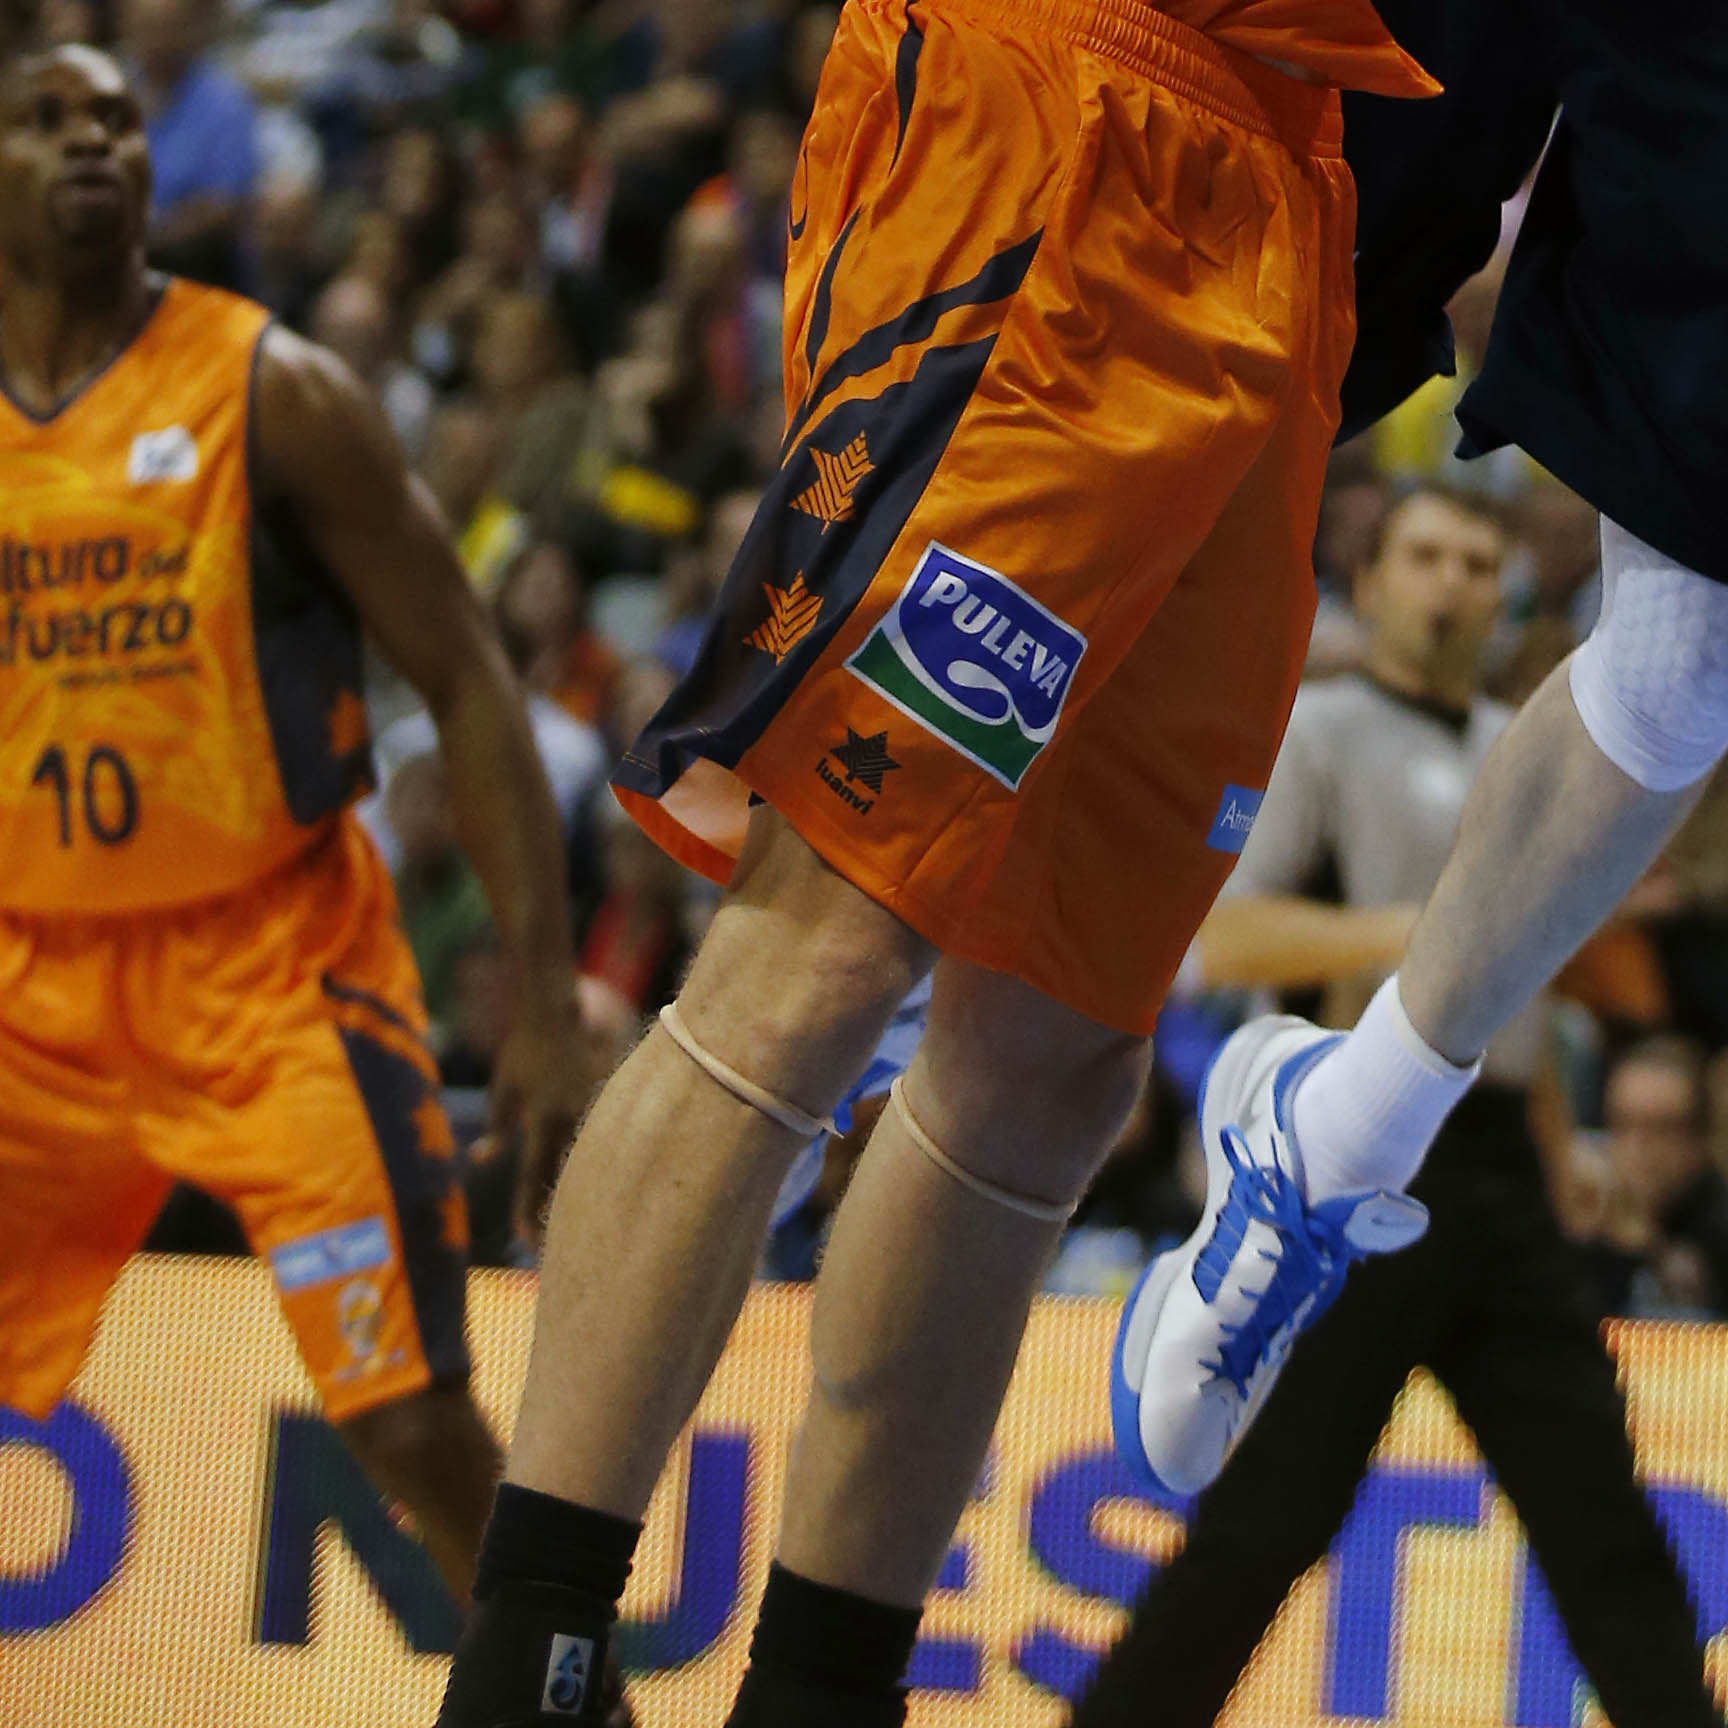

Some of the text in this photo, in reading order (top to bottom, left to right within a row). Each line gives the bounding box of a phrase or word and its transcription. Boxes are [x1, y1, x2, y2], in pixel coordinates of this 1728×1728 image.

[918, 570, 1069, 699] PULEVA
[32, 743, 138, 848] 10
[815, 756, 875, 817] luanvi
